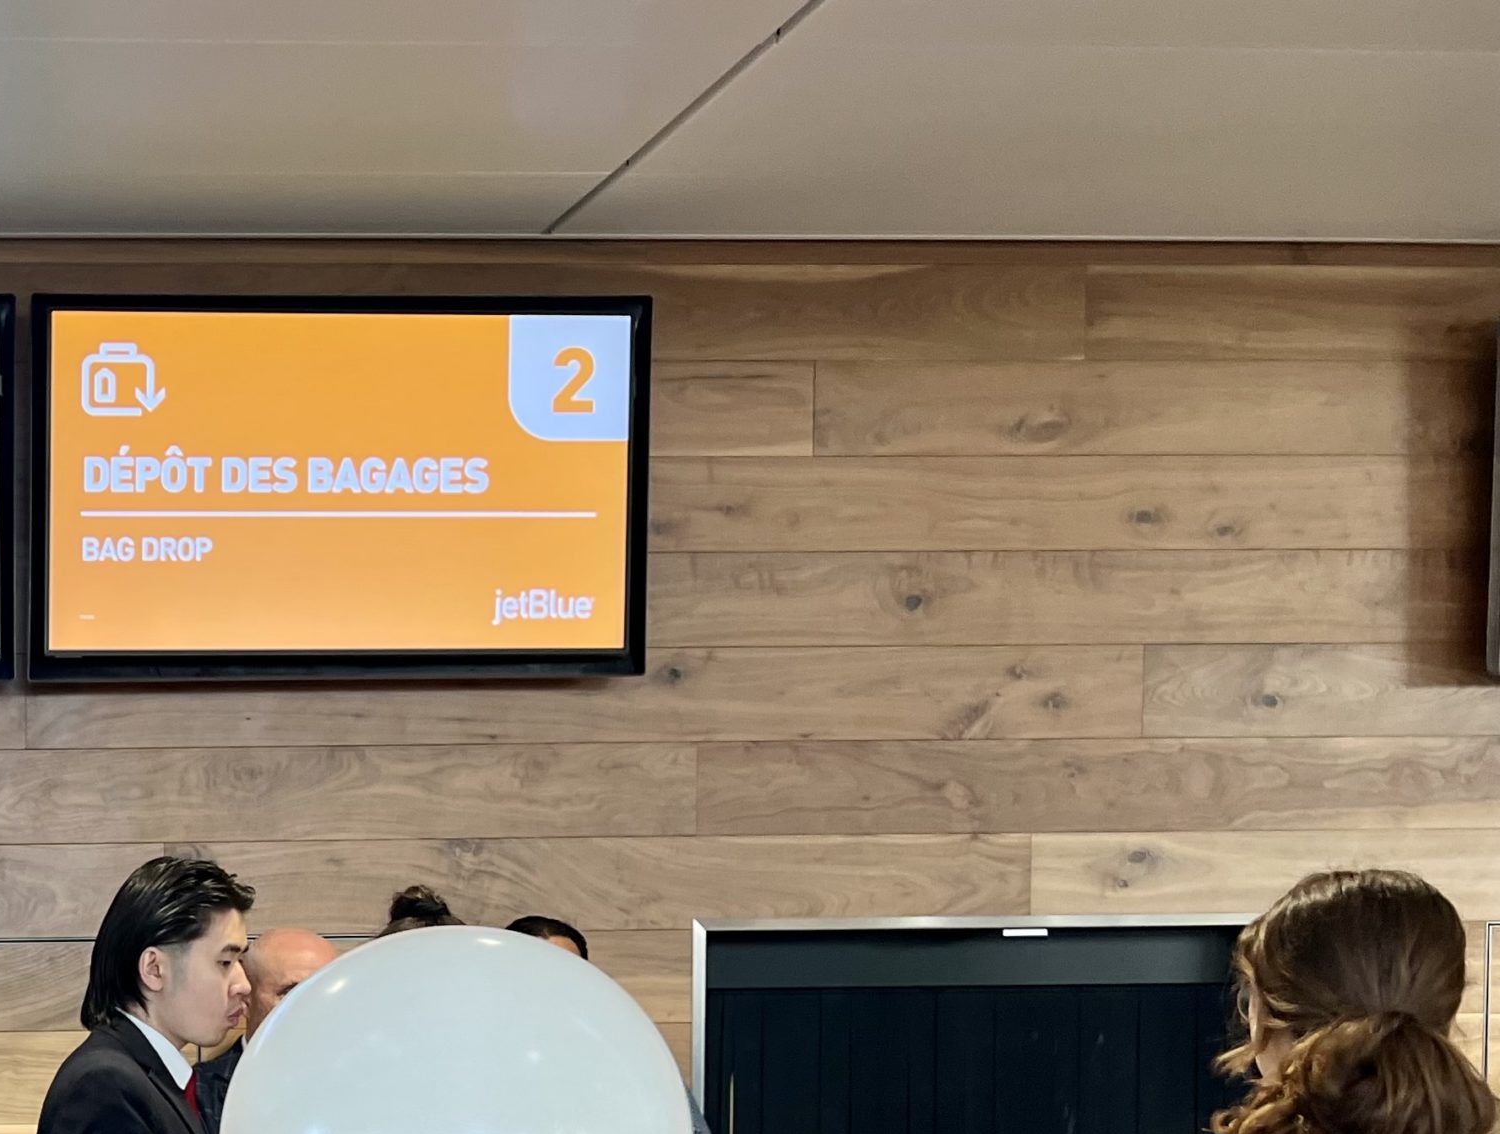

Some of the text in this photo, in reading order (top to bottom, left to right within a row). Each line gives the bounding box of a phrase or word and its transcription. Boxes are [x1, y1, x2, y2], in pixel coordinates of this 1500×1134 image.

[551, 346, 596, 415] 2
[82, 445, 490, 495] DÉPÔT DES BAGAGES
[81, 536, 213, 563] BAG DROP
[491, 588, 592, 626] jetBlue
